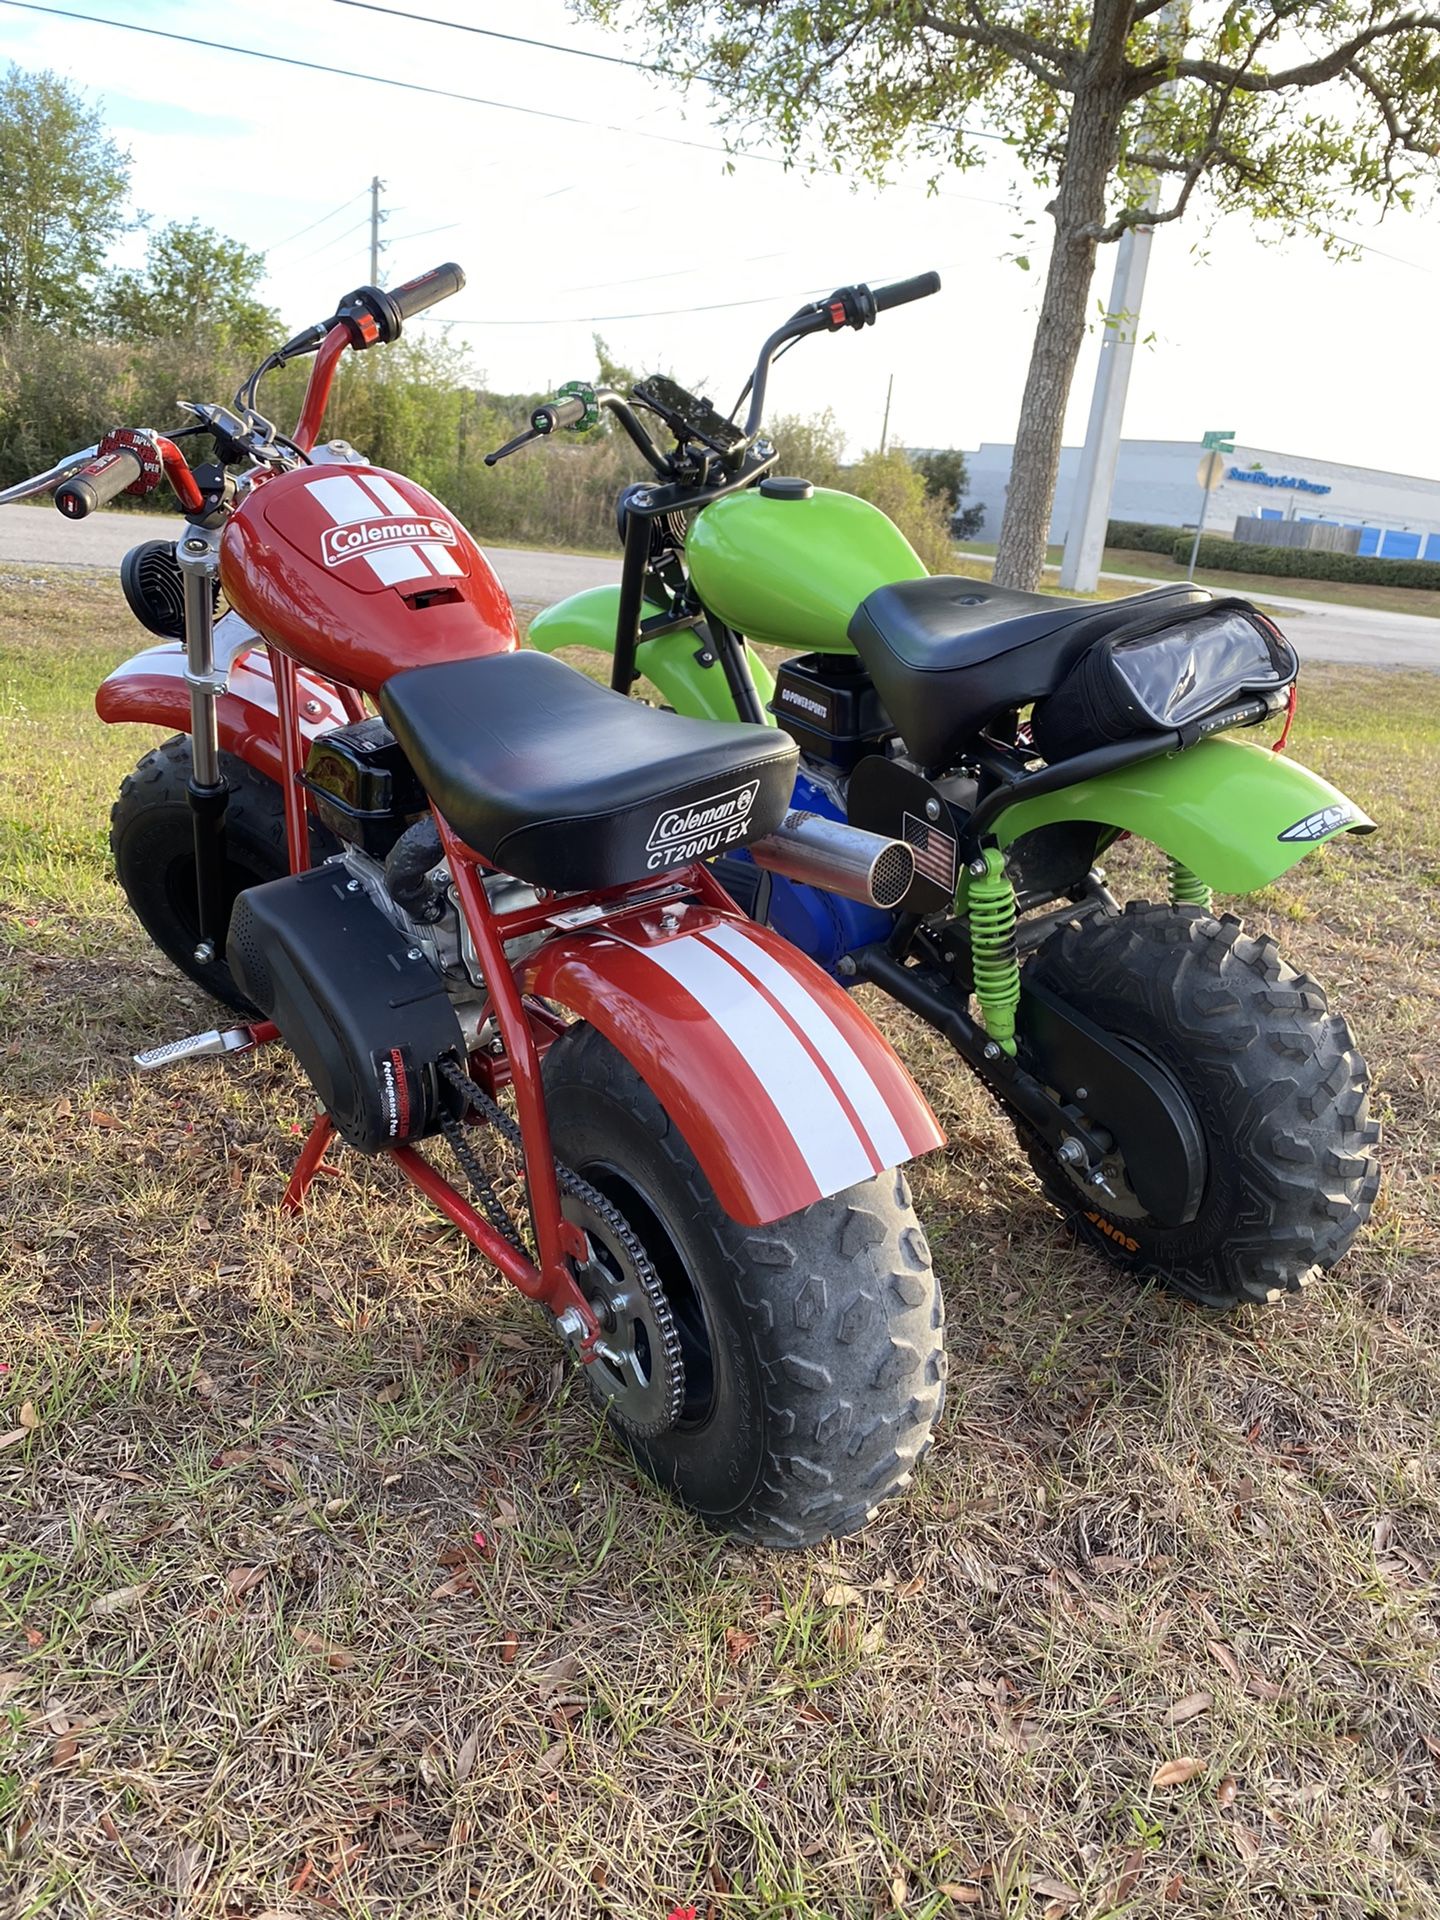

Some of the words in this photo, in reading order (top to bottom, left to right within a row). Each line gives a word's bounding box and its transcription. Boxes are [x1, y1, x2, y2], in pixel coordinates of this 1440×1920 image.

[330, 523, 430, 552] Coleman
[659, 800, 737, 838] Coleman
[646, 817, 752, 870] CT200U-EX
[382, 1061, 398, 1118] Performance
